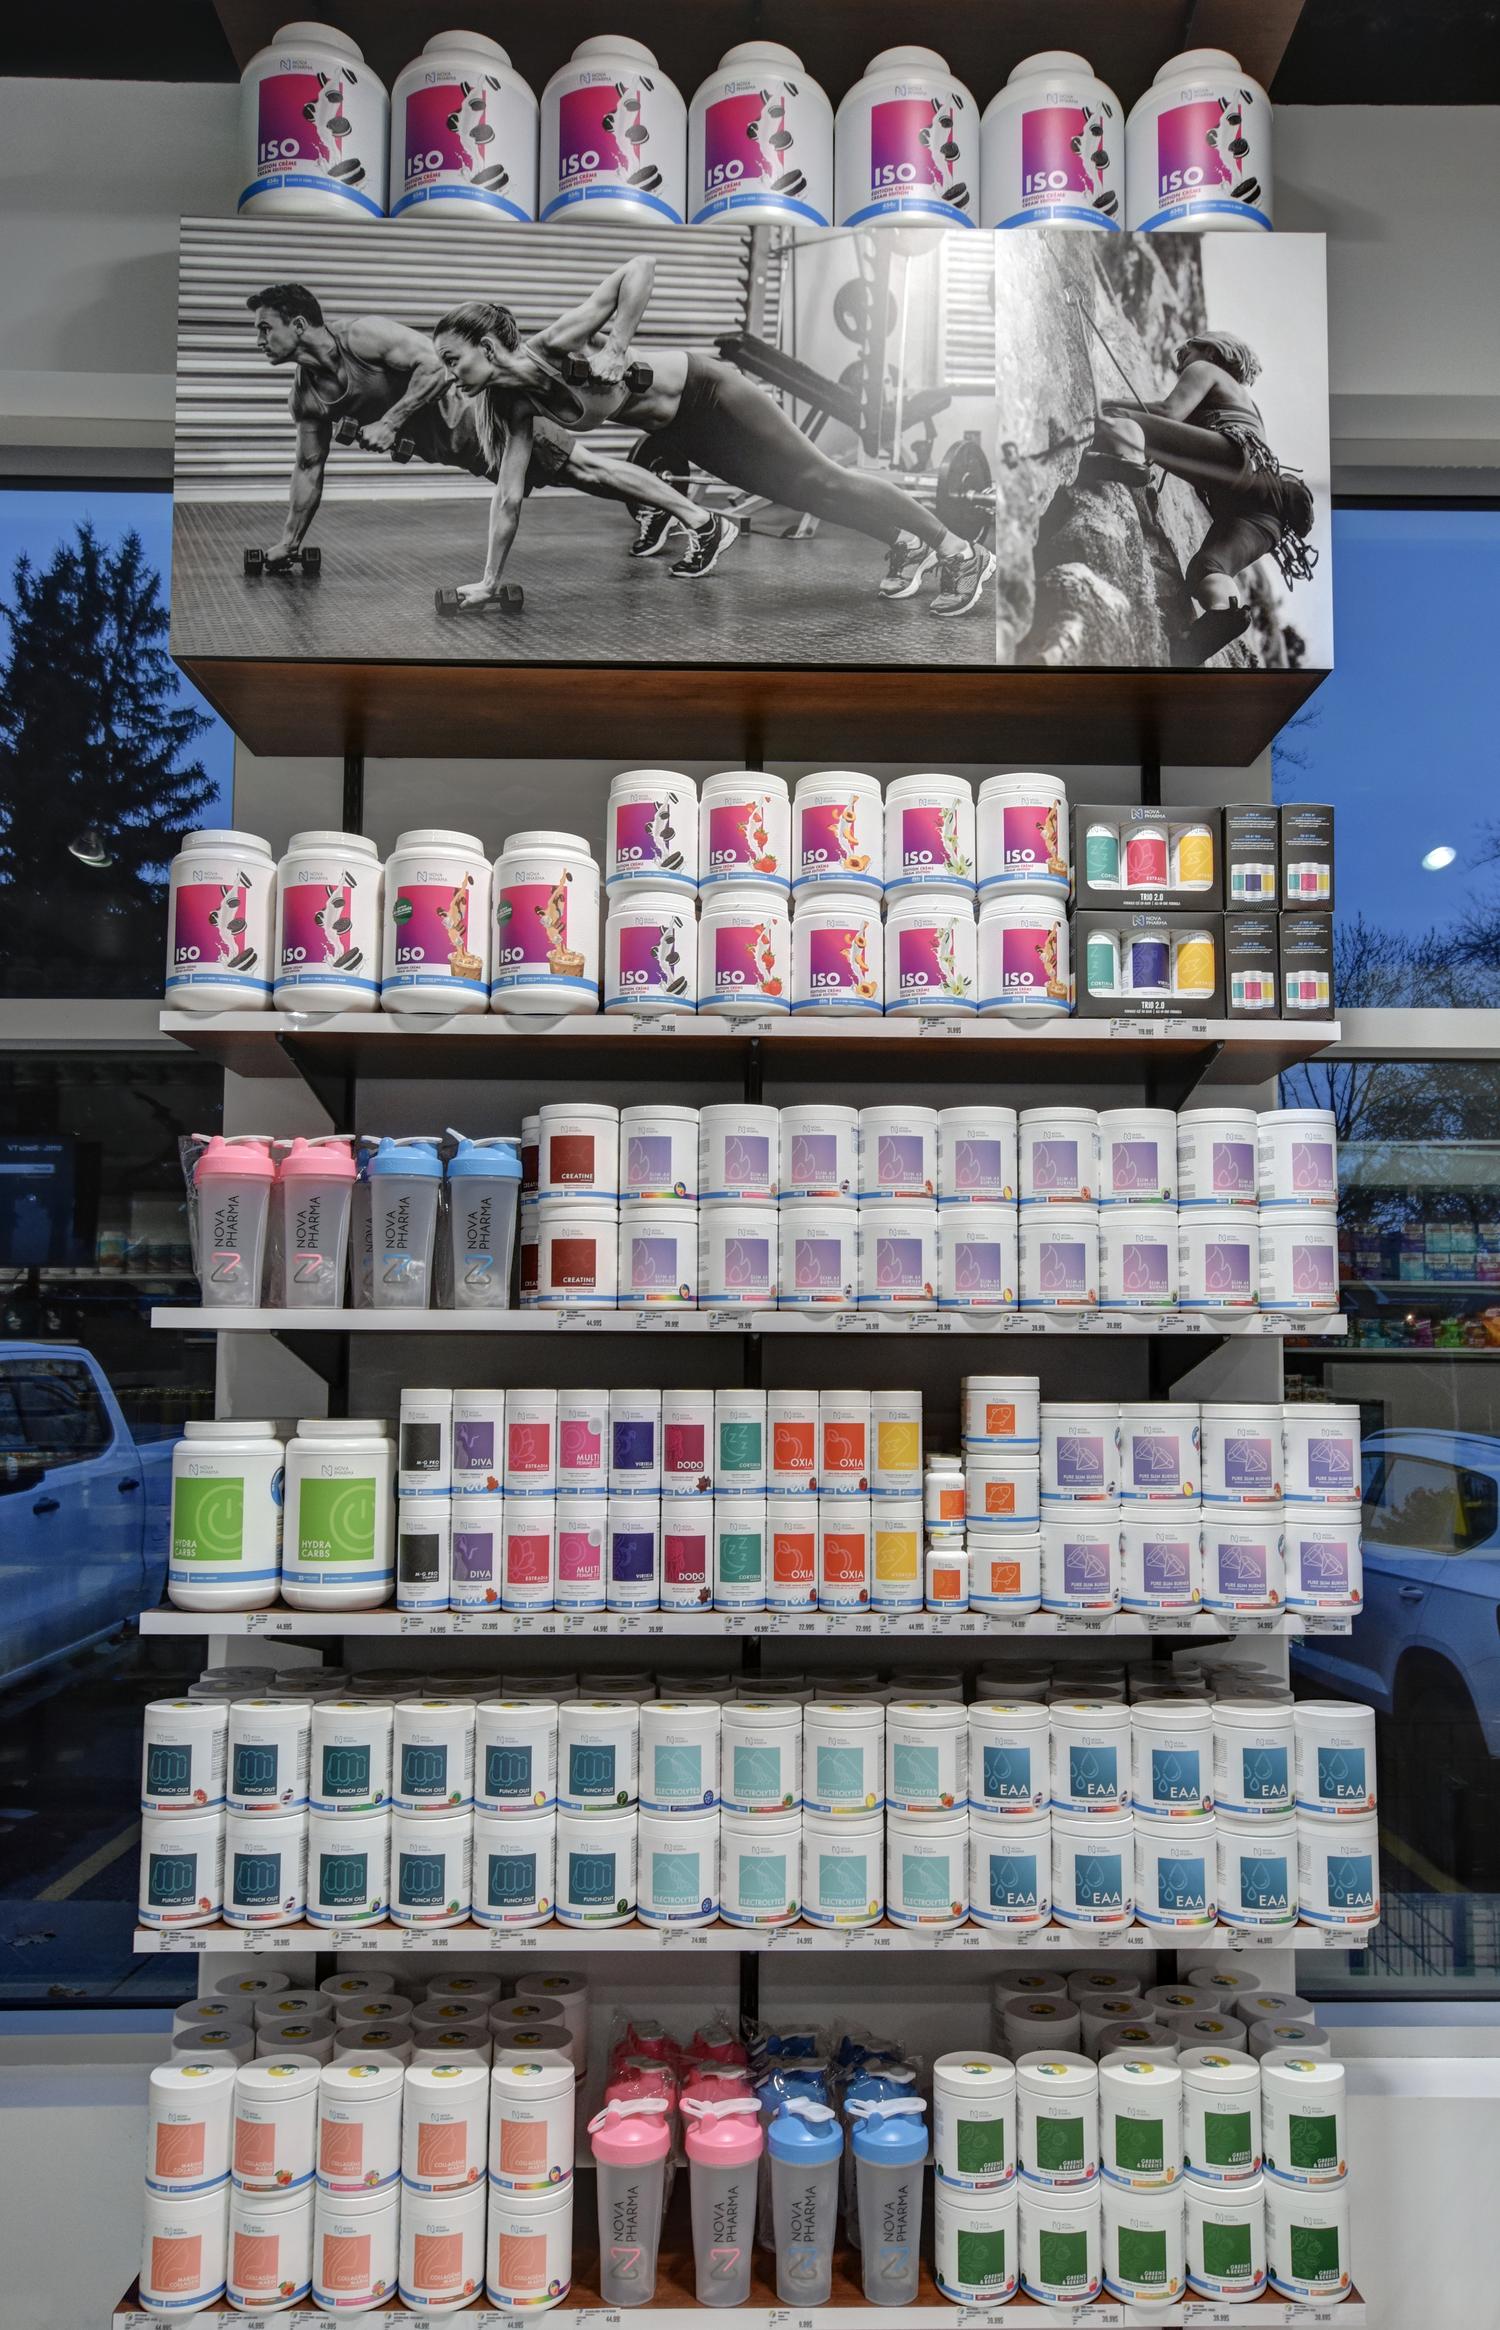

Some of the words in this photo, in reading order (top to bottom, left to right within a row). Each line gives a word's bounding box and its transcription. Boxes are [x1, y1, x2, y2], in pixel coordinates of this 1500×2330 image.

[260, 138, 300, 162] ISO
[258, 162, 278, 173] EDITION
[271, 165, 293, 173] EDITION
[407, 150, 444, 176] ISO
[561, 150, 600, 177] ISO
[706, 159, 744, 186] ISO
[874, 162, 917, 186] ISO
[1162, 166, 1204, 190] ISO
[1025, 170, 1068, 193] ISO
[871, 187, 894, 196] EDITION
[617, 846, 643, 861] ISO
[711, 849, 736, 864] ISO
[803, 848, 828, 864] ISO
[905, 850, 933, 865] ISO
[1006, 848, 1035, 864] ISO
[1140, 893, 1152, 902] TRIO
[1153, 893, 1164, 902] 2.0
[175, 946, 200, 962] ISO
[282, 947, 307, 962] ISO
[397, 946, 425, 962] ISO
[500, 947, 525, 963] ISO
[621, 970, 648, 985] ISO
[717, 970, 745, 985] ISO
[812, 972, 840, 987] ISO
[901, 972, 929, 987] ISO
[1004, 972, 1034, 986] ISO
[1141, 1001, 1153, 1010] TRIO
[1154, 1001, 1165, 1010] 2.0
[214, 1209, 225, 1247] NOVA
[225, 1195, 239, 1248] PHARMA
[296, 1210, 306, 1248] NOVA
[308, 1196, 320, 1248] PHARMA
[385, 1210, 397, 1248] NOVA
[398, 1196, 411, 1248] PHARMA
[479, 1197, 492, 1249] PHARMA
[468, 1211, 478, 1249] NOVA
[471, 1458, 492, 1466] DIVA
[577, 1453, 600, 1461] MULTI
[791, 1458, 813, 1467] OXIA
[839, 1458, 864, 1467] OXIA
[677, 1461, 704, 1469] DODO
[175, 1540, 197, 1549] HYDRA
[301, 1540, 332, 1549] HYDRA
[175, 1548, 196, 1557] CARBS
[301, 1549, 330, 1558] CARBS
[470, 1570, 491, 1578] DIVA
[577, 1566, 600, 1574] MULTI
[679, 1572, 705, 1581] DODO
[791, 1570, 813, 1579] OXIA
[840, 1570, 864, 1579] OXIA
[1000, 1784, 1029, 1796] EAA
[1087, 1783, 1116, 1795] EAA
[1170, 1787, 1199, 1798] EAA
[1261, 1784, 1287, 1796] EAA
[1337, 1784, 1365, 1796] EAA
[1007, 1892, 1035, 1904] EAA
[1093, 1892, 1121, 1904] EAA
[1176, 1895, 1204, 1907] EAA
[1259, 1894, 1286, 1906] EAA
[1347, 1893, 1372, 1904] EAA
[626, 2185, 639, 2242] PHARMA
[726, 2185, 738, 2242] PHARMA
[803, 2185, 816, 2242] PHARMA
[896, 2185, 908, 2242] PHARMA
[614, 2201, 624, 2242] NOVA
[714, 2202, 724, 2242] NOVA
[792, 2201, 802, 2242] NOVA
[884, 2201, 895, 2242] NOVA
